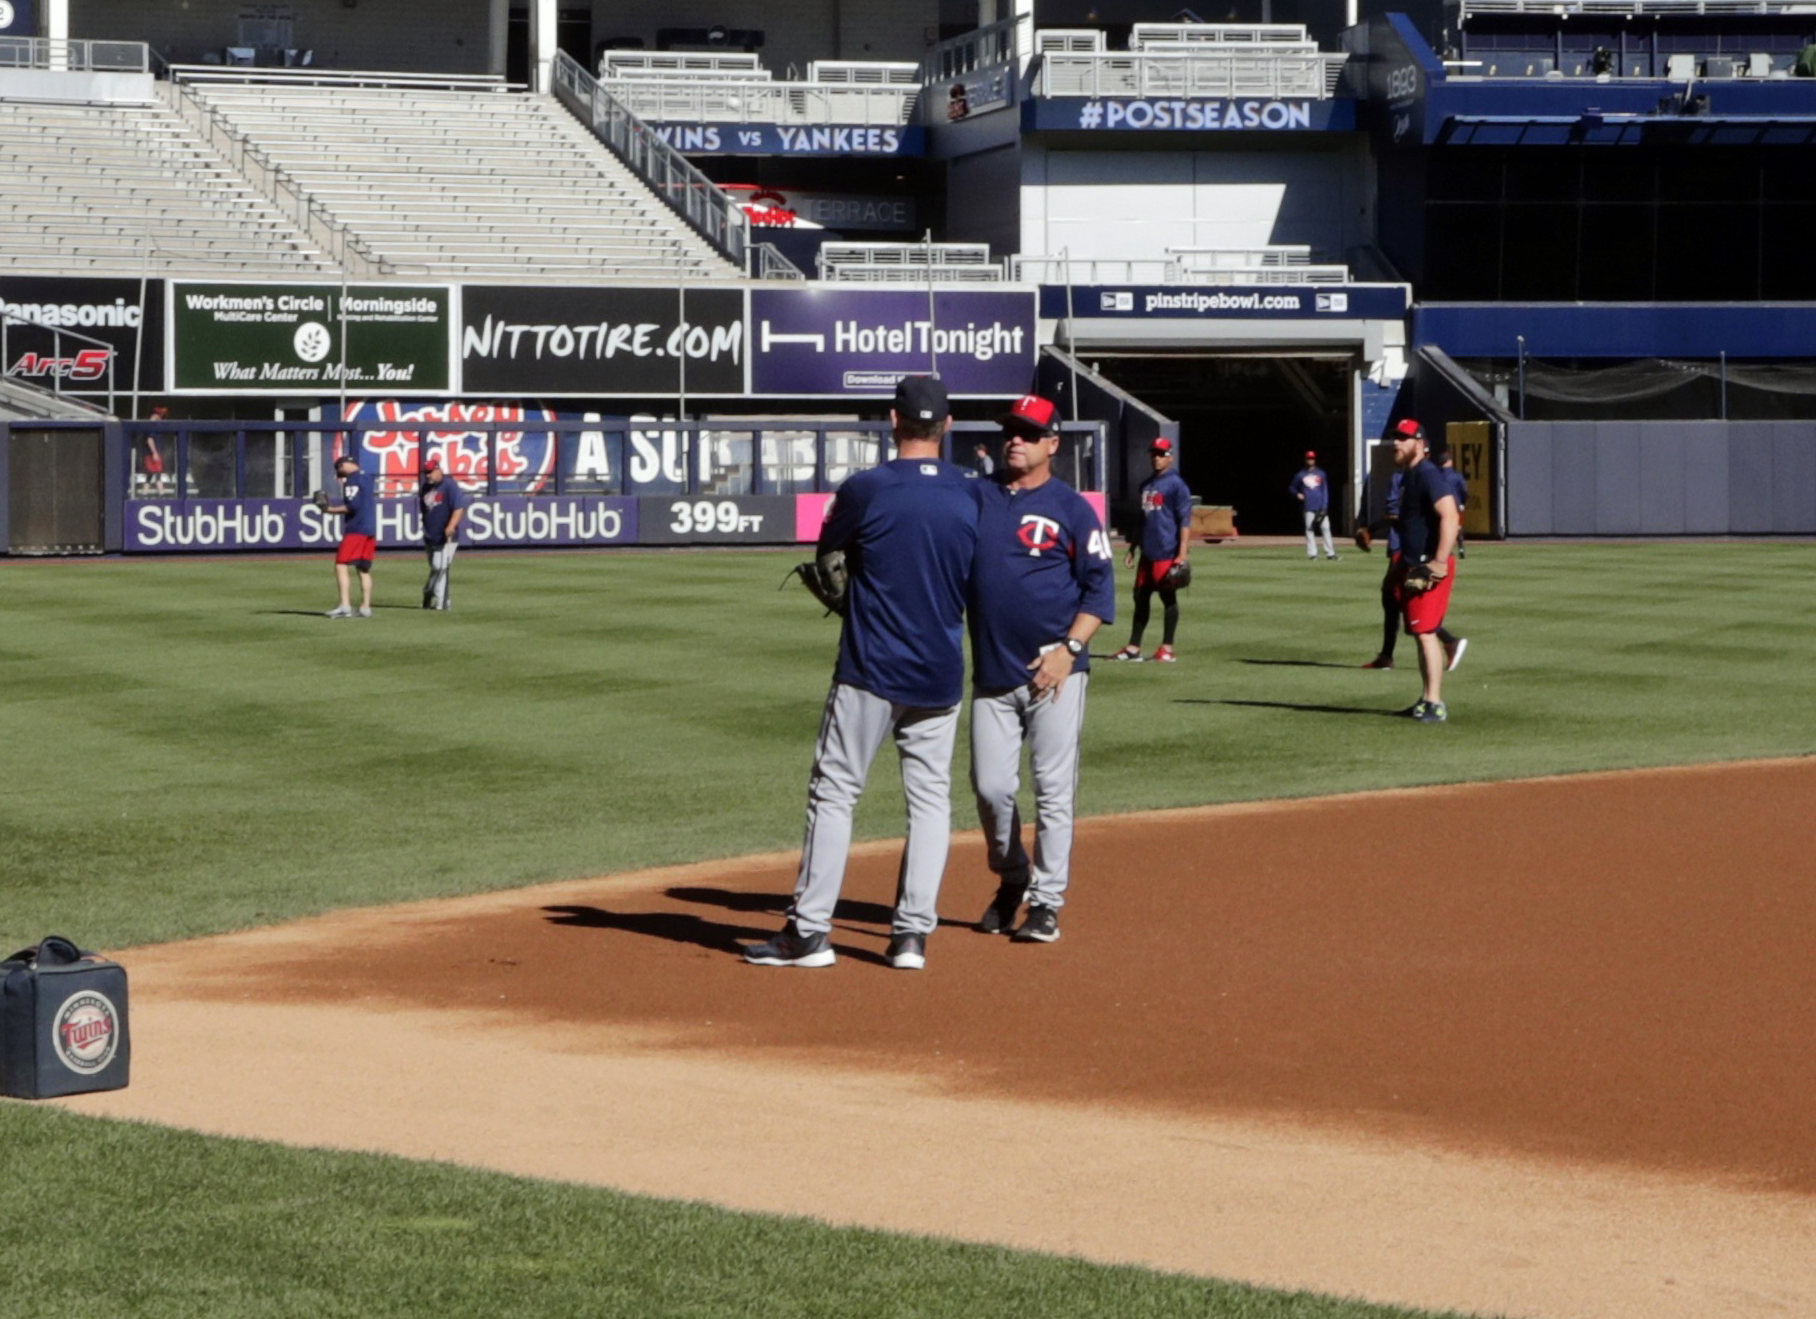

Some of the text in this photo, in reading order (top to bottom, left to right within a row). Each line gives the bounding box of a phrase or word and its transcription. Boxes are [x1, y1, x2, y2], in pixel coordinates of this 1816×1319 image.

[1079, 100, 1311, 130] #POSTSEASON
[650, 127, 722, 151] WINS
[776, 128, 900, 153] YANKEES
[807, 199, 906, 223] TERRACE
[186, 294, 437, 315] Workmen's Circle Morningside
[1146, 292, 1300, 313] pinstripebowl.com
[264, 312, 298, 323] Center
[463, 313, 743, 365] NITTOTIRE.COM
[6, 349, 110, 380] Arc5
[213, 361, 256, 381] What
[259, 362, 320, 381] Matters
[137, 501, 621, 545] StubHub StubHub
